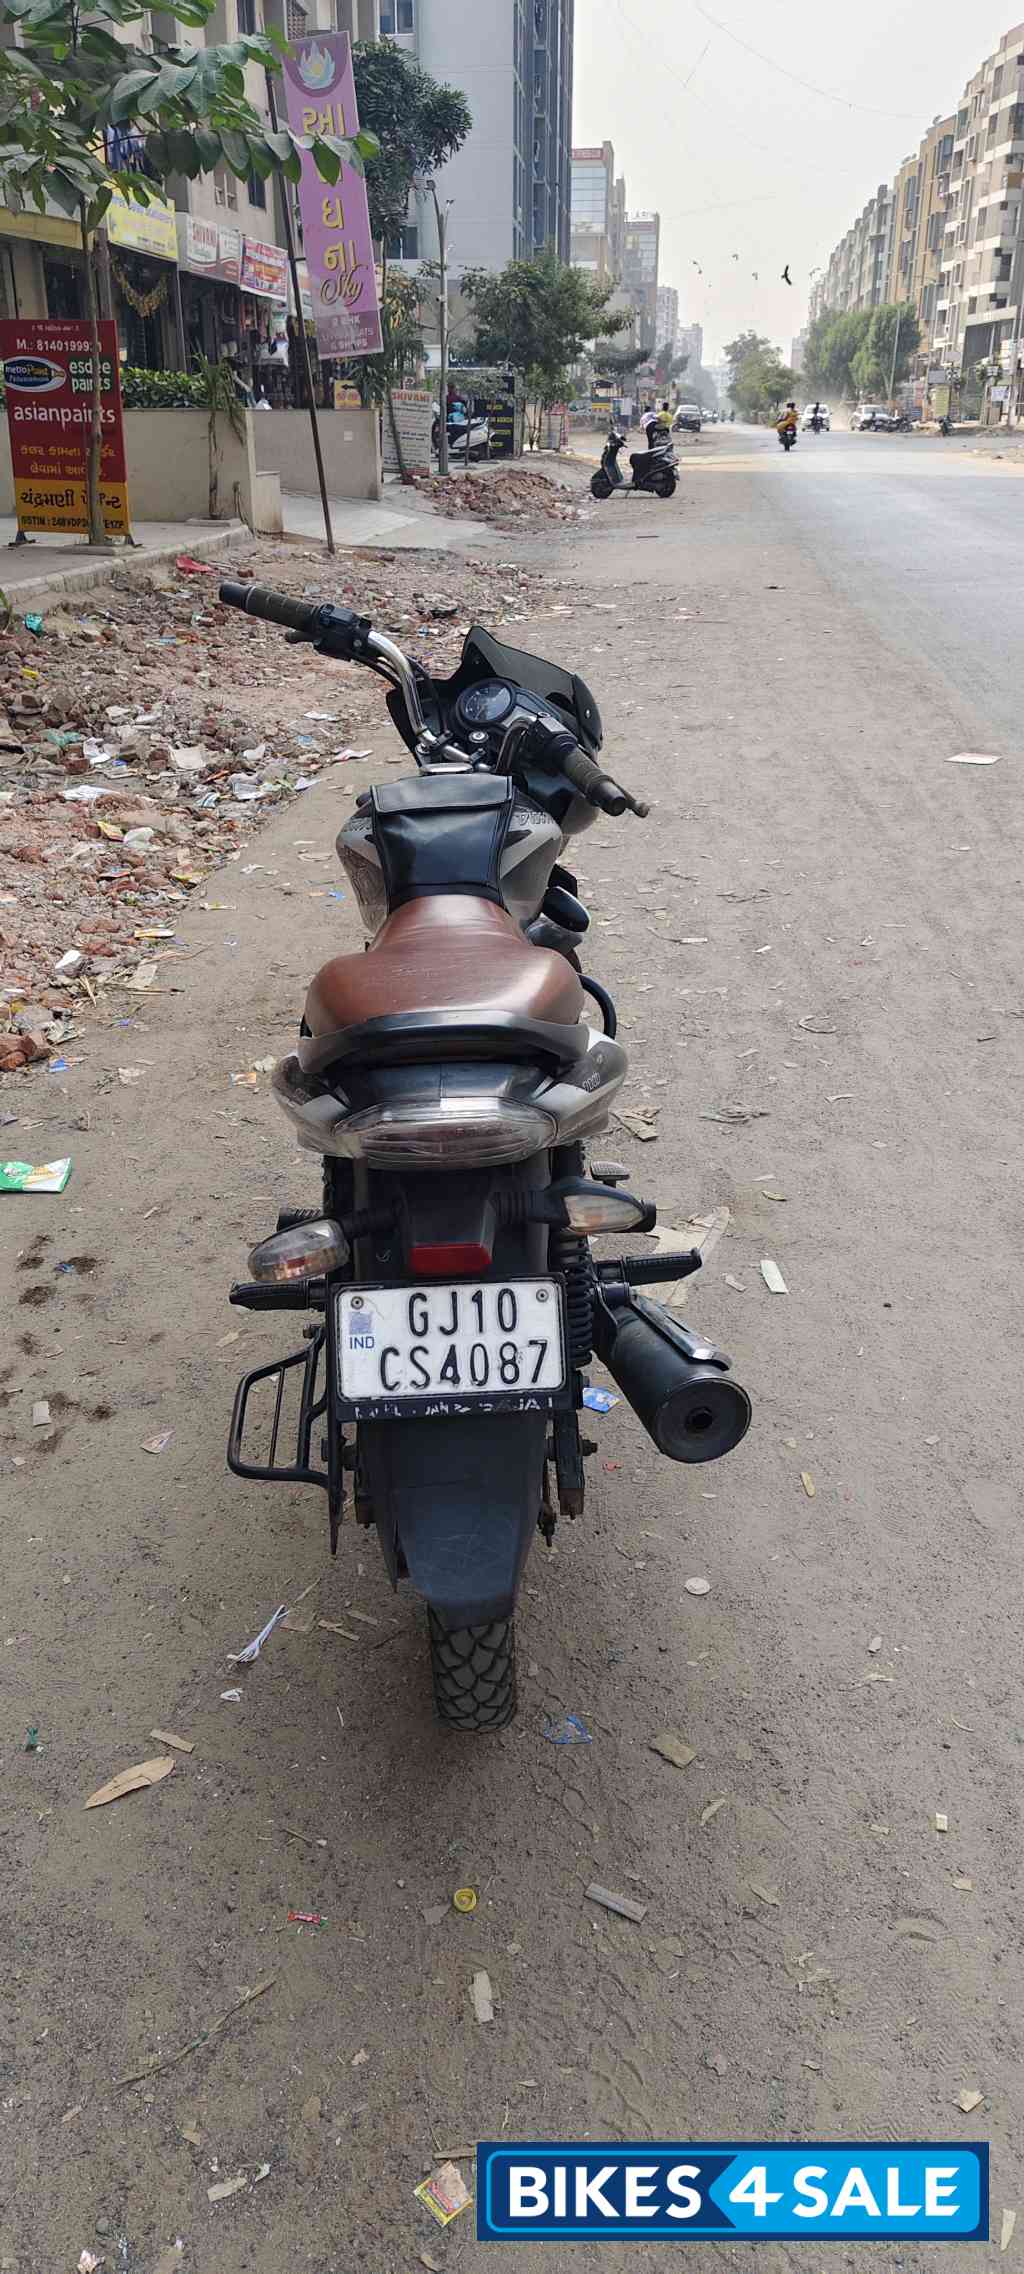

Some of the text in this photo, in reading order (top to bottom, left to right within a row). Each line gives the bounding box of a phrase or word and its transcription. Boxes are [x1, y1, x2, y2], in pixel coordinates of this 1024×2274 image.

[320, 264, 366, 306] Sky
[69, 358, 111, 374] esde
[409, 1287, 517, 1337] GJ10
[349, 1336, 375, 1349] IND
[380, 1338, 548, 1391] CS4087
